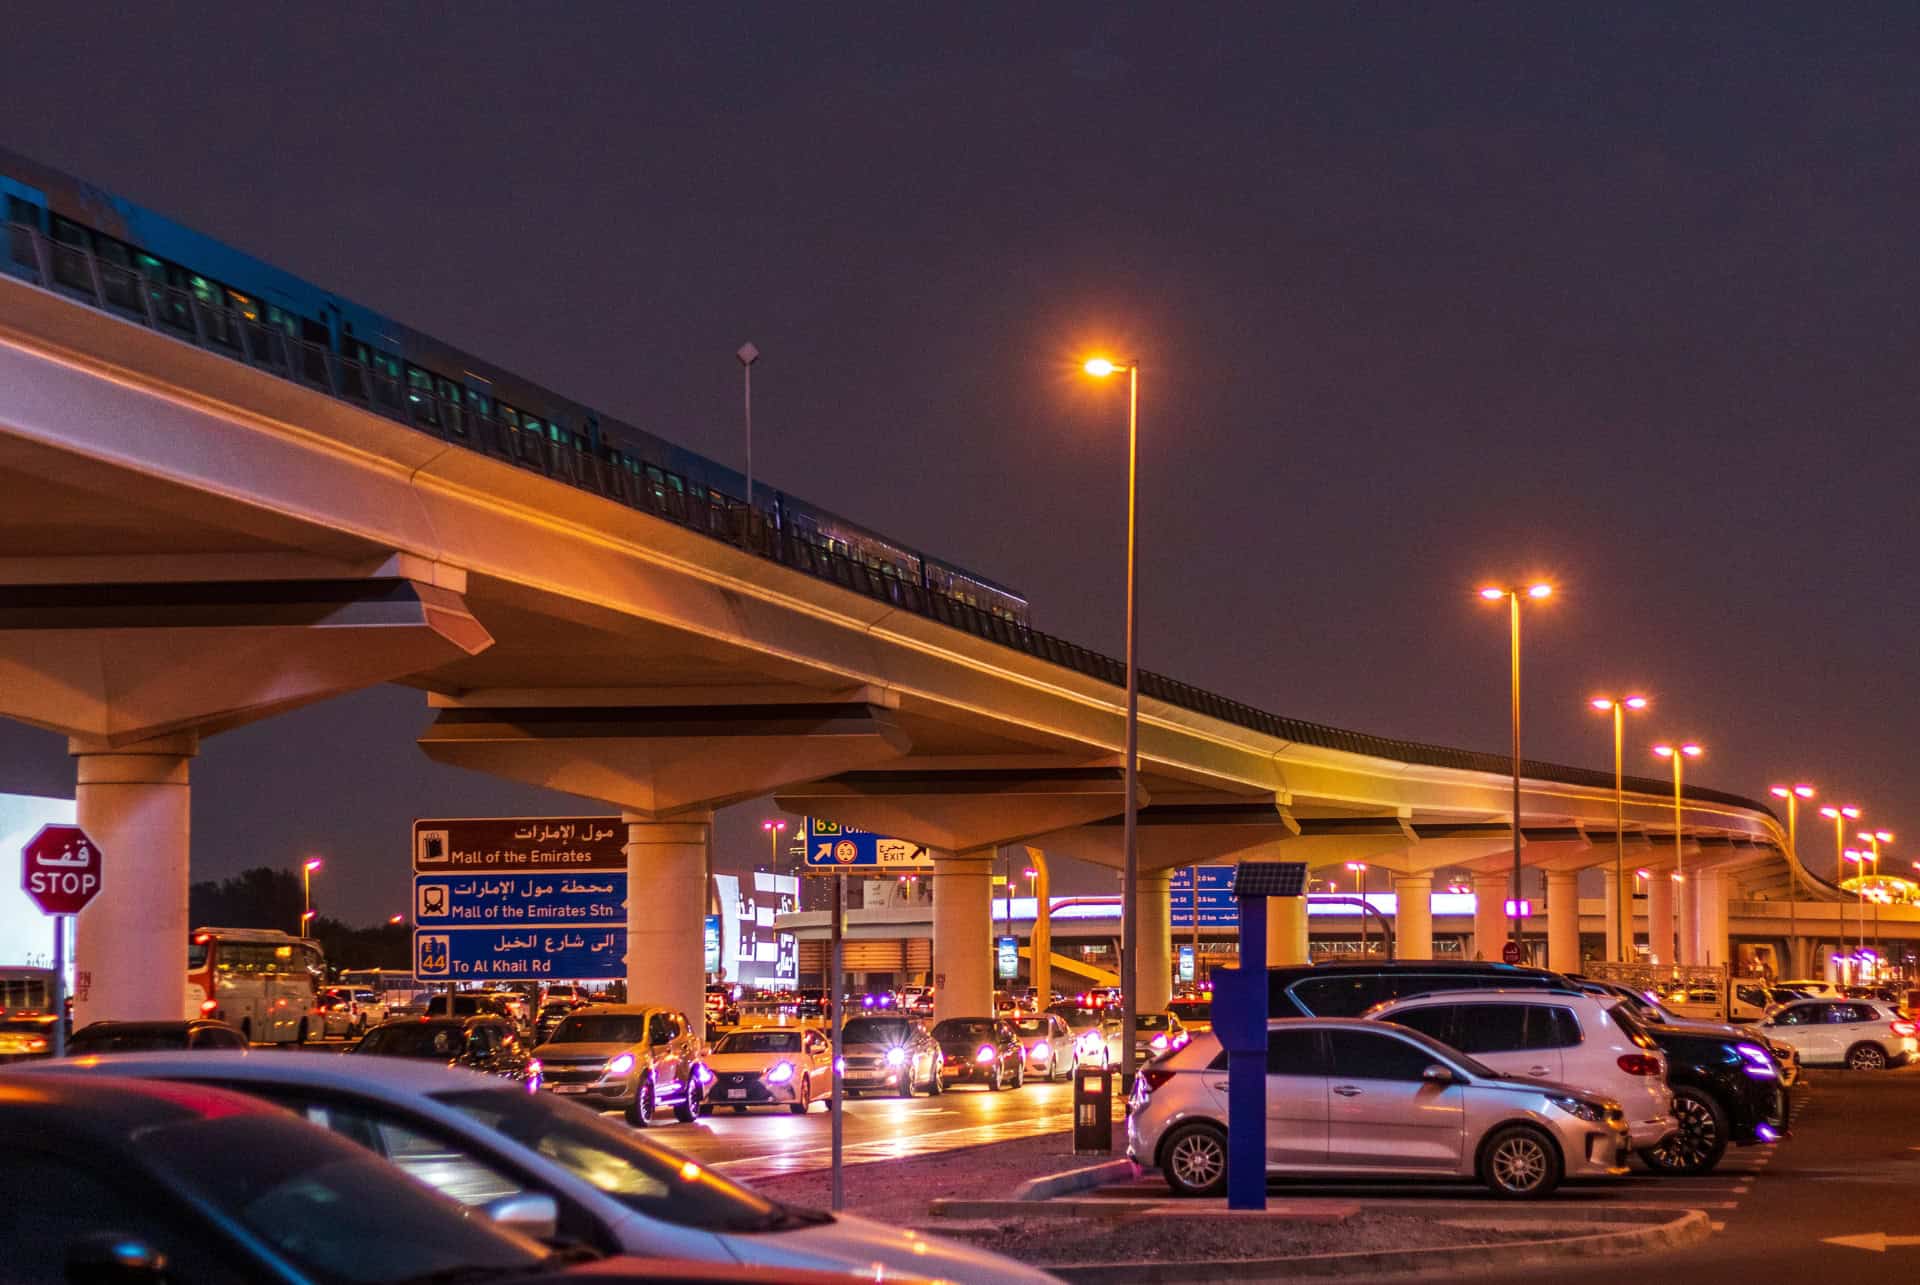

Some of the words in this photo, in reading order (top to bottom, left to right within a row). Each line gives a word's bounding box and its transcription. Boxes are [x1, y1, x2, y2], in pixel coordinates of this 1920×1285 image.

[514, 824, 575, 845] الإمارات
[581, 823, 614, 841] مول
[36, 839, 89, 868] قف
[451, 851, 483, 865] Mall
[485, 850, 500, 863] of
[503, 850, 527, 863] the
[530, 849, 592, 863] Emirates
[883, 853, 904, 861] EXIT
[30, 871, 96, 895] STOP
[454, 879, 515, 901] الإمارات
[520, 879, 553, 898] مول
[560, 879, 614, 895] محطة
[451, 905, 482, 919] Mall
[484, 904, 499, 918] of
[501, 904, 524, 918] the
[527, 903, 587, 918] Emirates
[589, 903, 614, 917] Stn
[493, 933, 537, 952] الخيل
[544, 933, 585, 953] شارع
[590, 933, 615, 954] إلى
[423, 954, 446, 969] 44
[453, 959, 470, 973] To
[473, 959, 488, 973] Al
[492, 959, 527, 973] Khail
[531, 959, 551, 973] Rd
